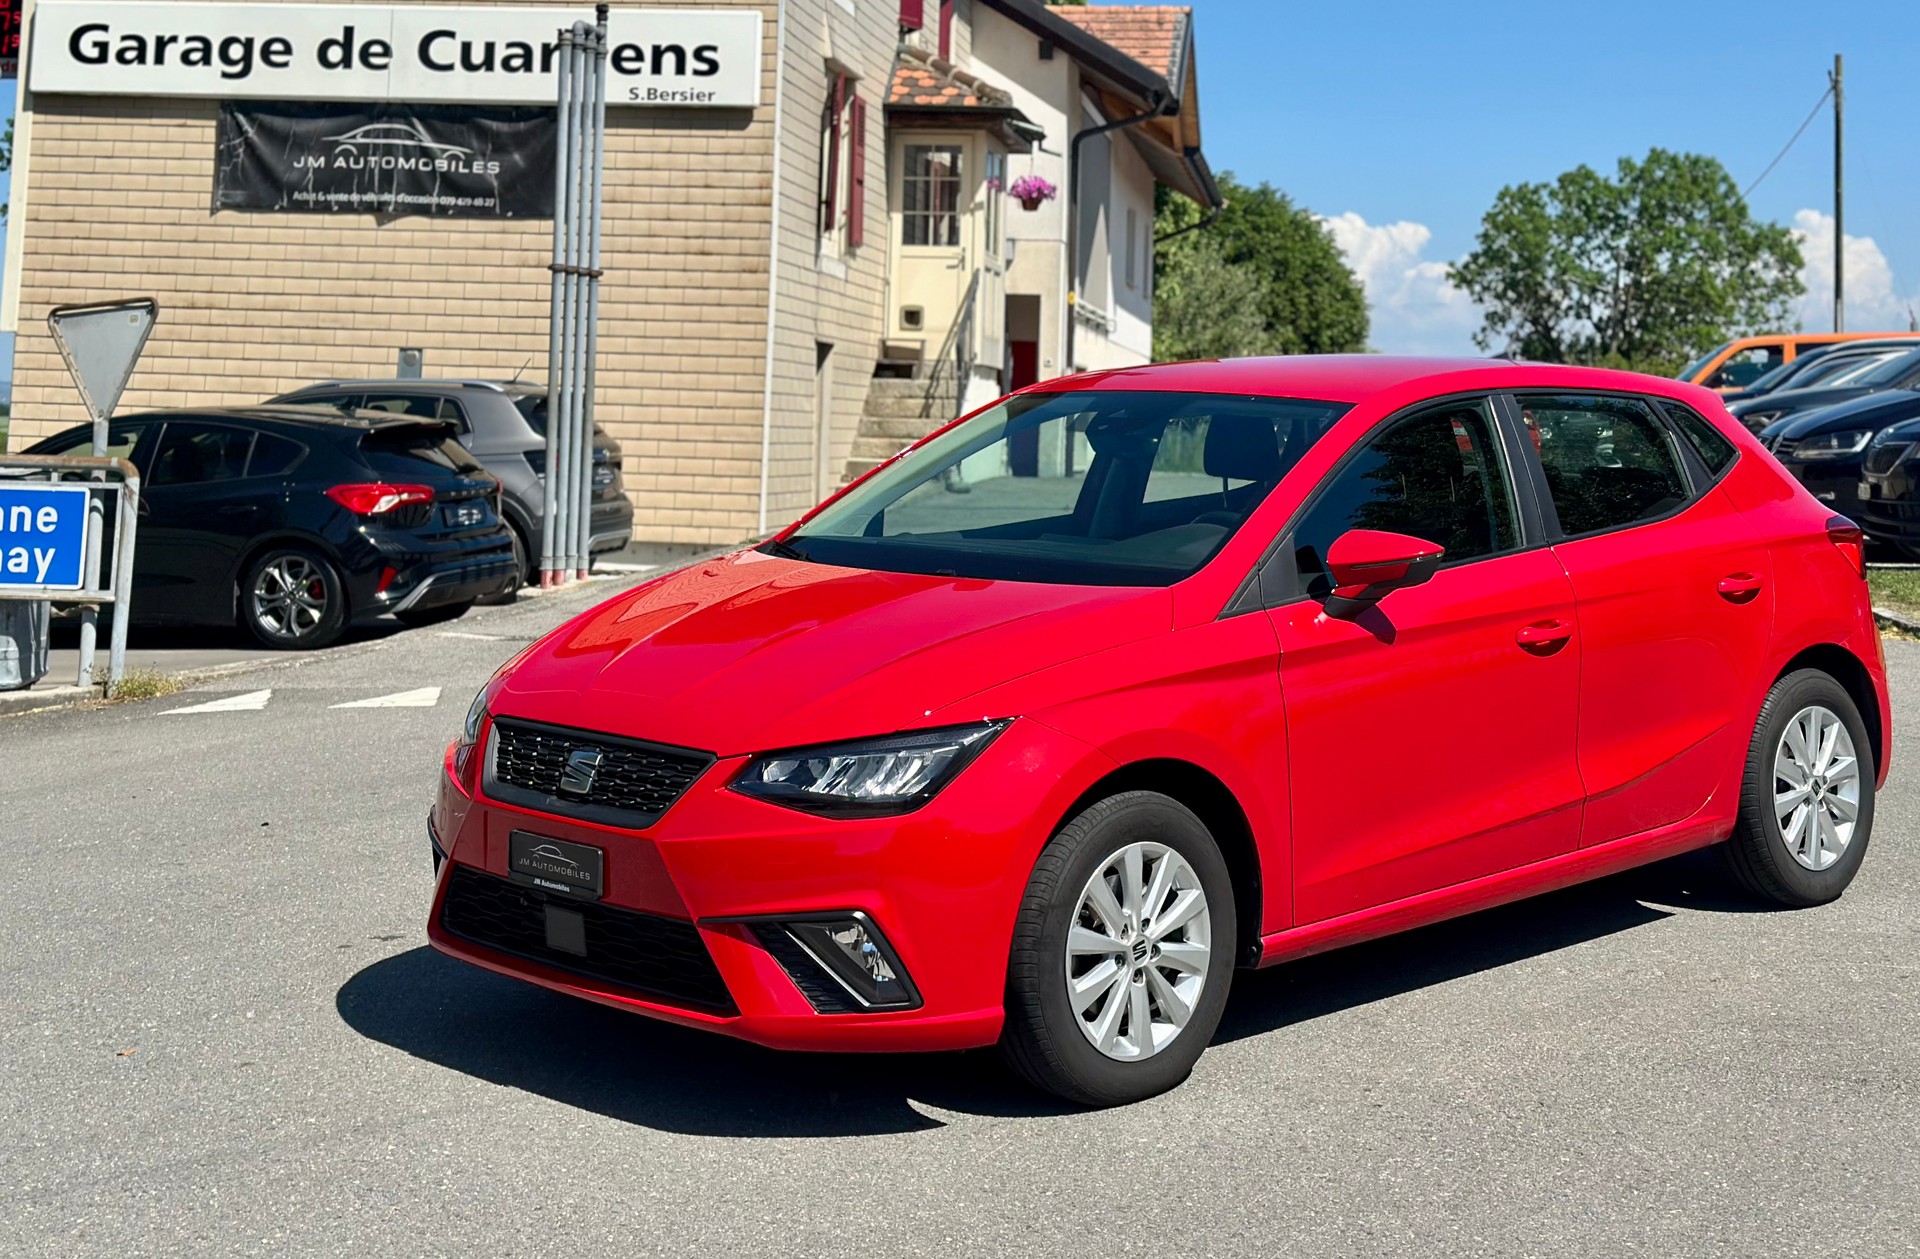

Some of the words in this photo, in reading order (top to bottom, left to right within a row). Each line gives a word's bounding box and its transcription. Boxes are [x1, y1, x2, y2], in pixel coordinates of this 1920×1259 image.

[68, 23, 294, 80] Garage
[316, 25, 393, 71] de
[417, 29, 720, 77] Cuarens
[629, 87, 716, 102] S.Bersier
[293, 156, 326, 168] JM
[333, 156, 500, 174] AUTOMOBILES
[0, 506, 58, 533] ne
[0, 547, 56, 583] ay
[519, 857, 530, 866] JM
[532, 861, 591, 881] AUTOMOBILES
